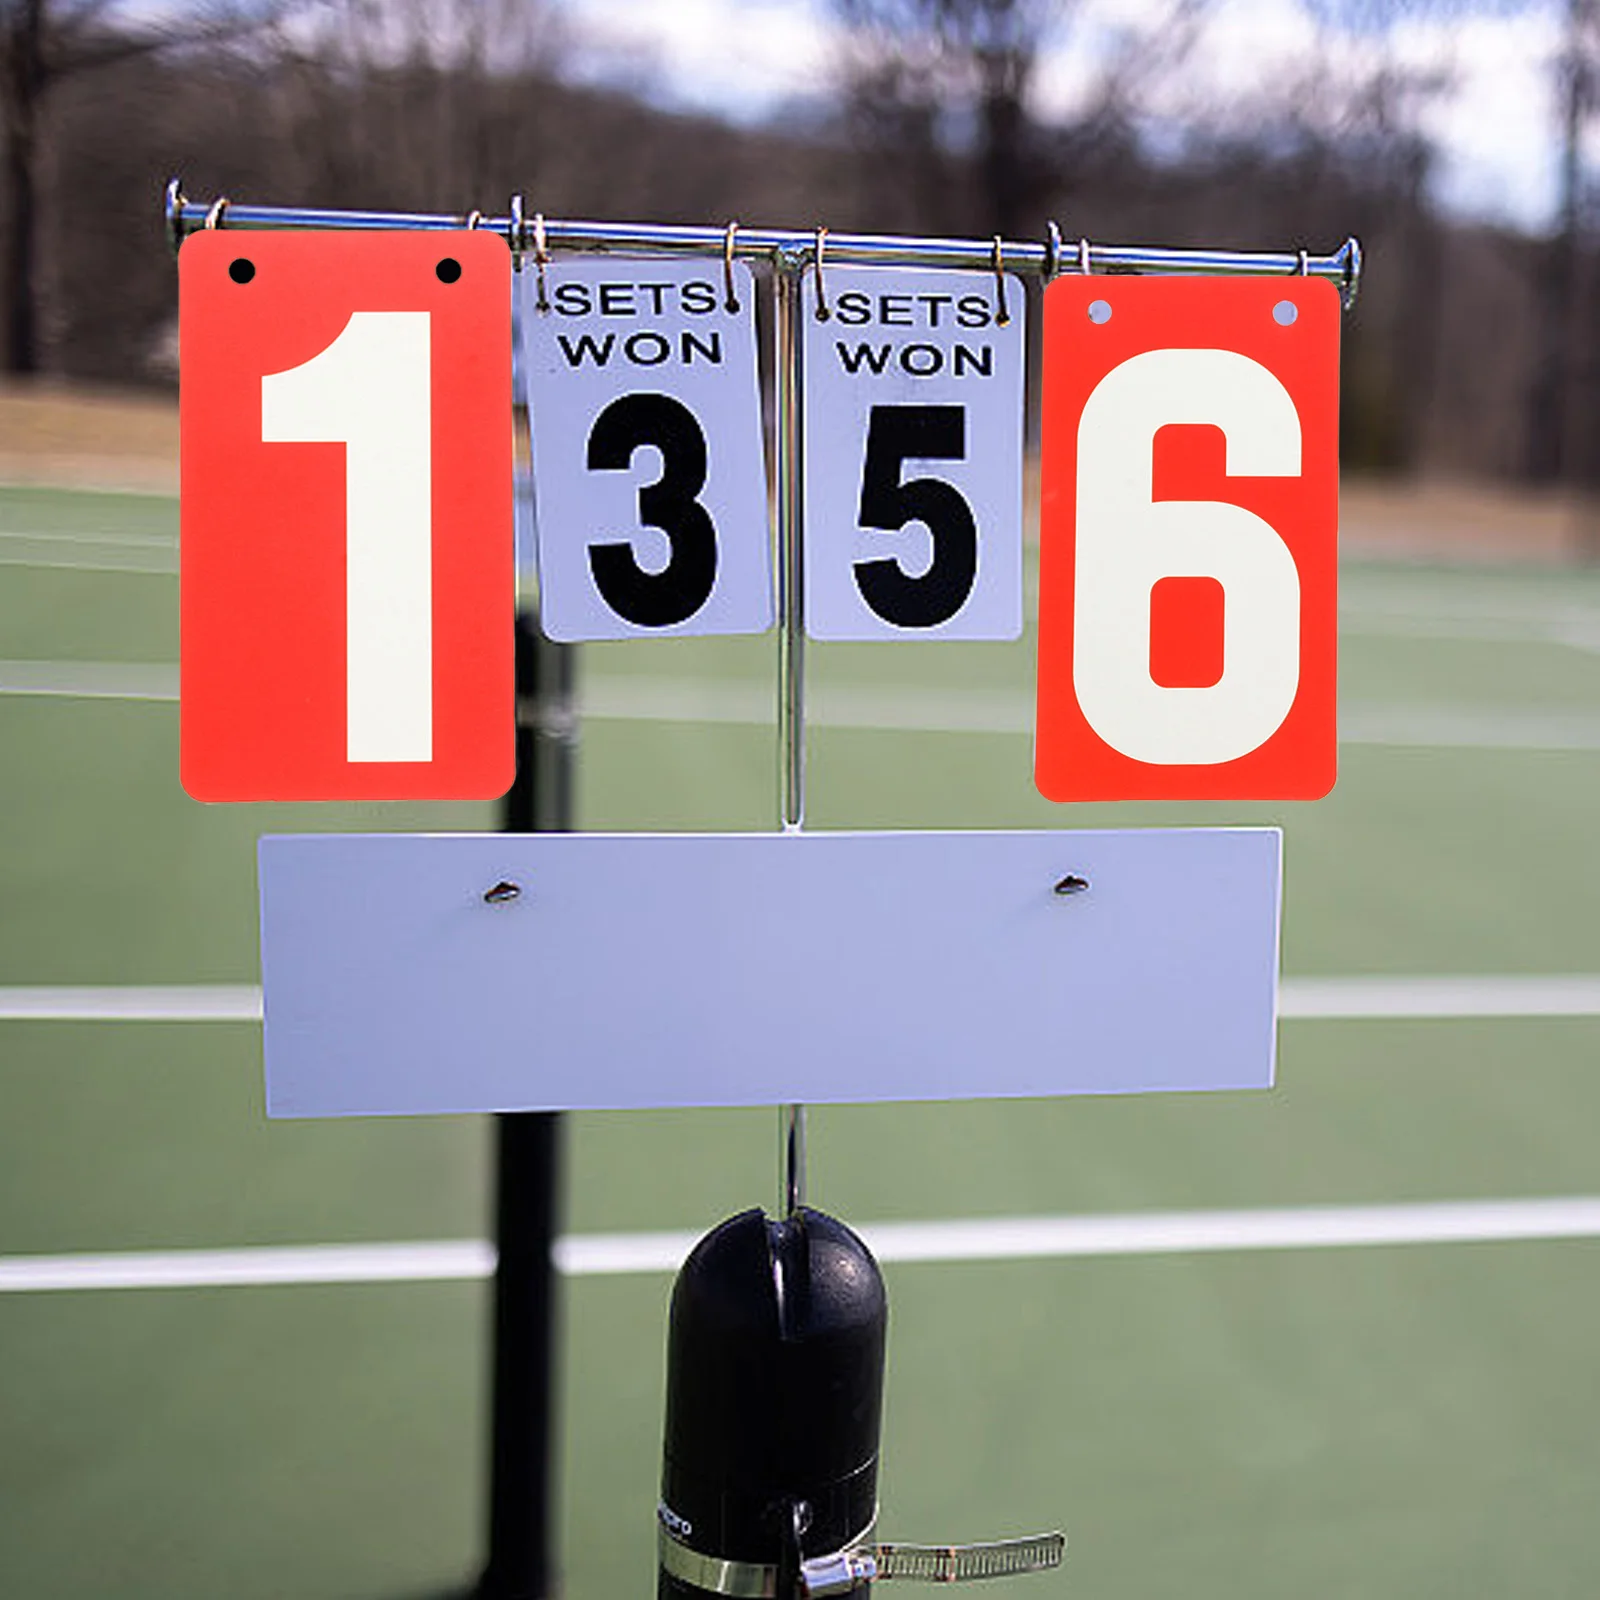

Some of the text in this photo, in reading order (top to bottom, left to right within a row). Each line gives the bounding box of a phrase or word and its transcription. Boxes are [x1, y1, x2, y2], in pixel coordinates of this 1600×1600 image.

[554, 282, 718, 317] SETS
[558, 333, 721, 367] WON
[836, 293, 991, 328] SETS
[836, 342, 992, 377] WON
[262, 312, 432, 763] 1
[587, 393, 717, 627] 3
[853, 405, 977, 627] 5
[1073, 349, 1302, 764] 6
